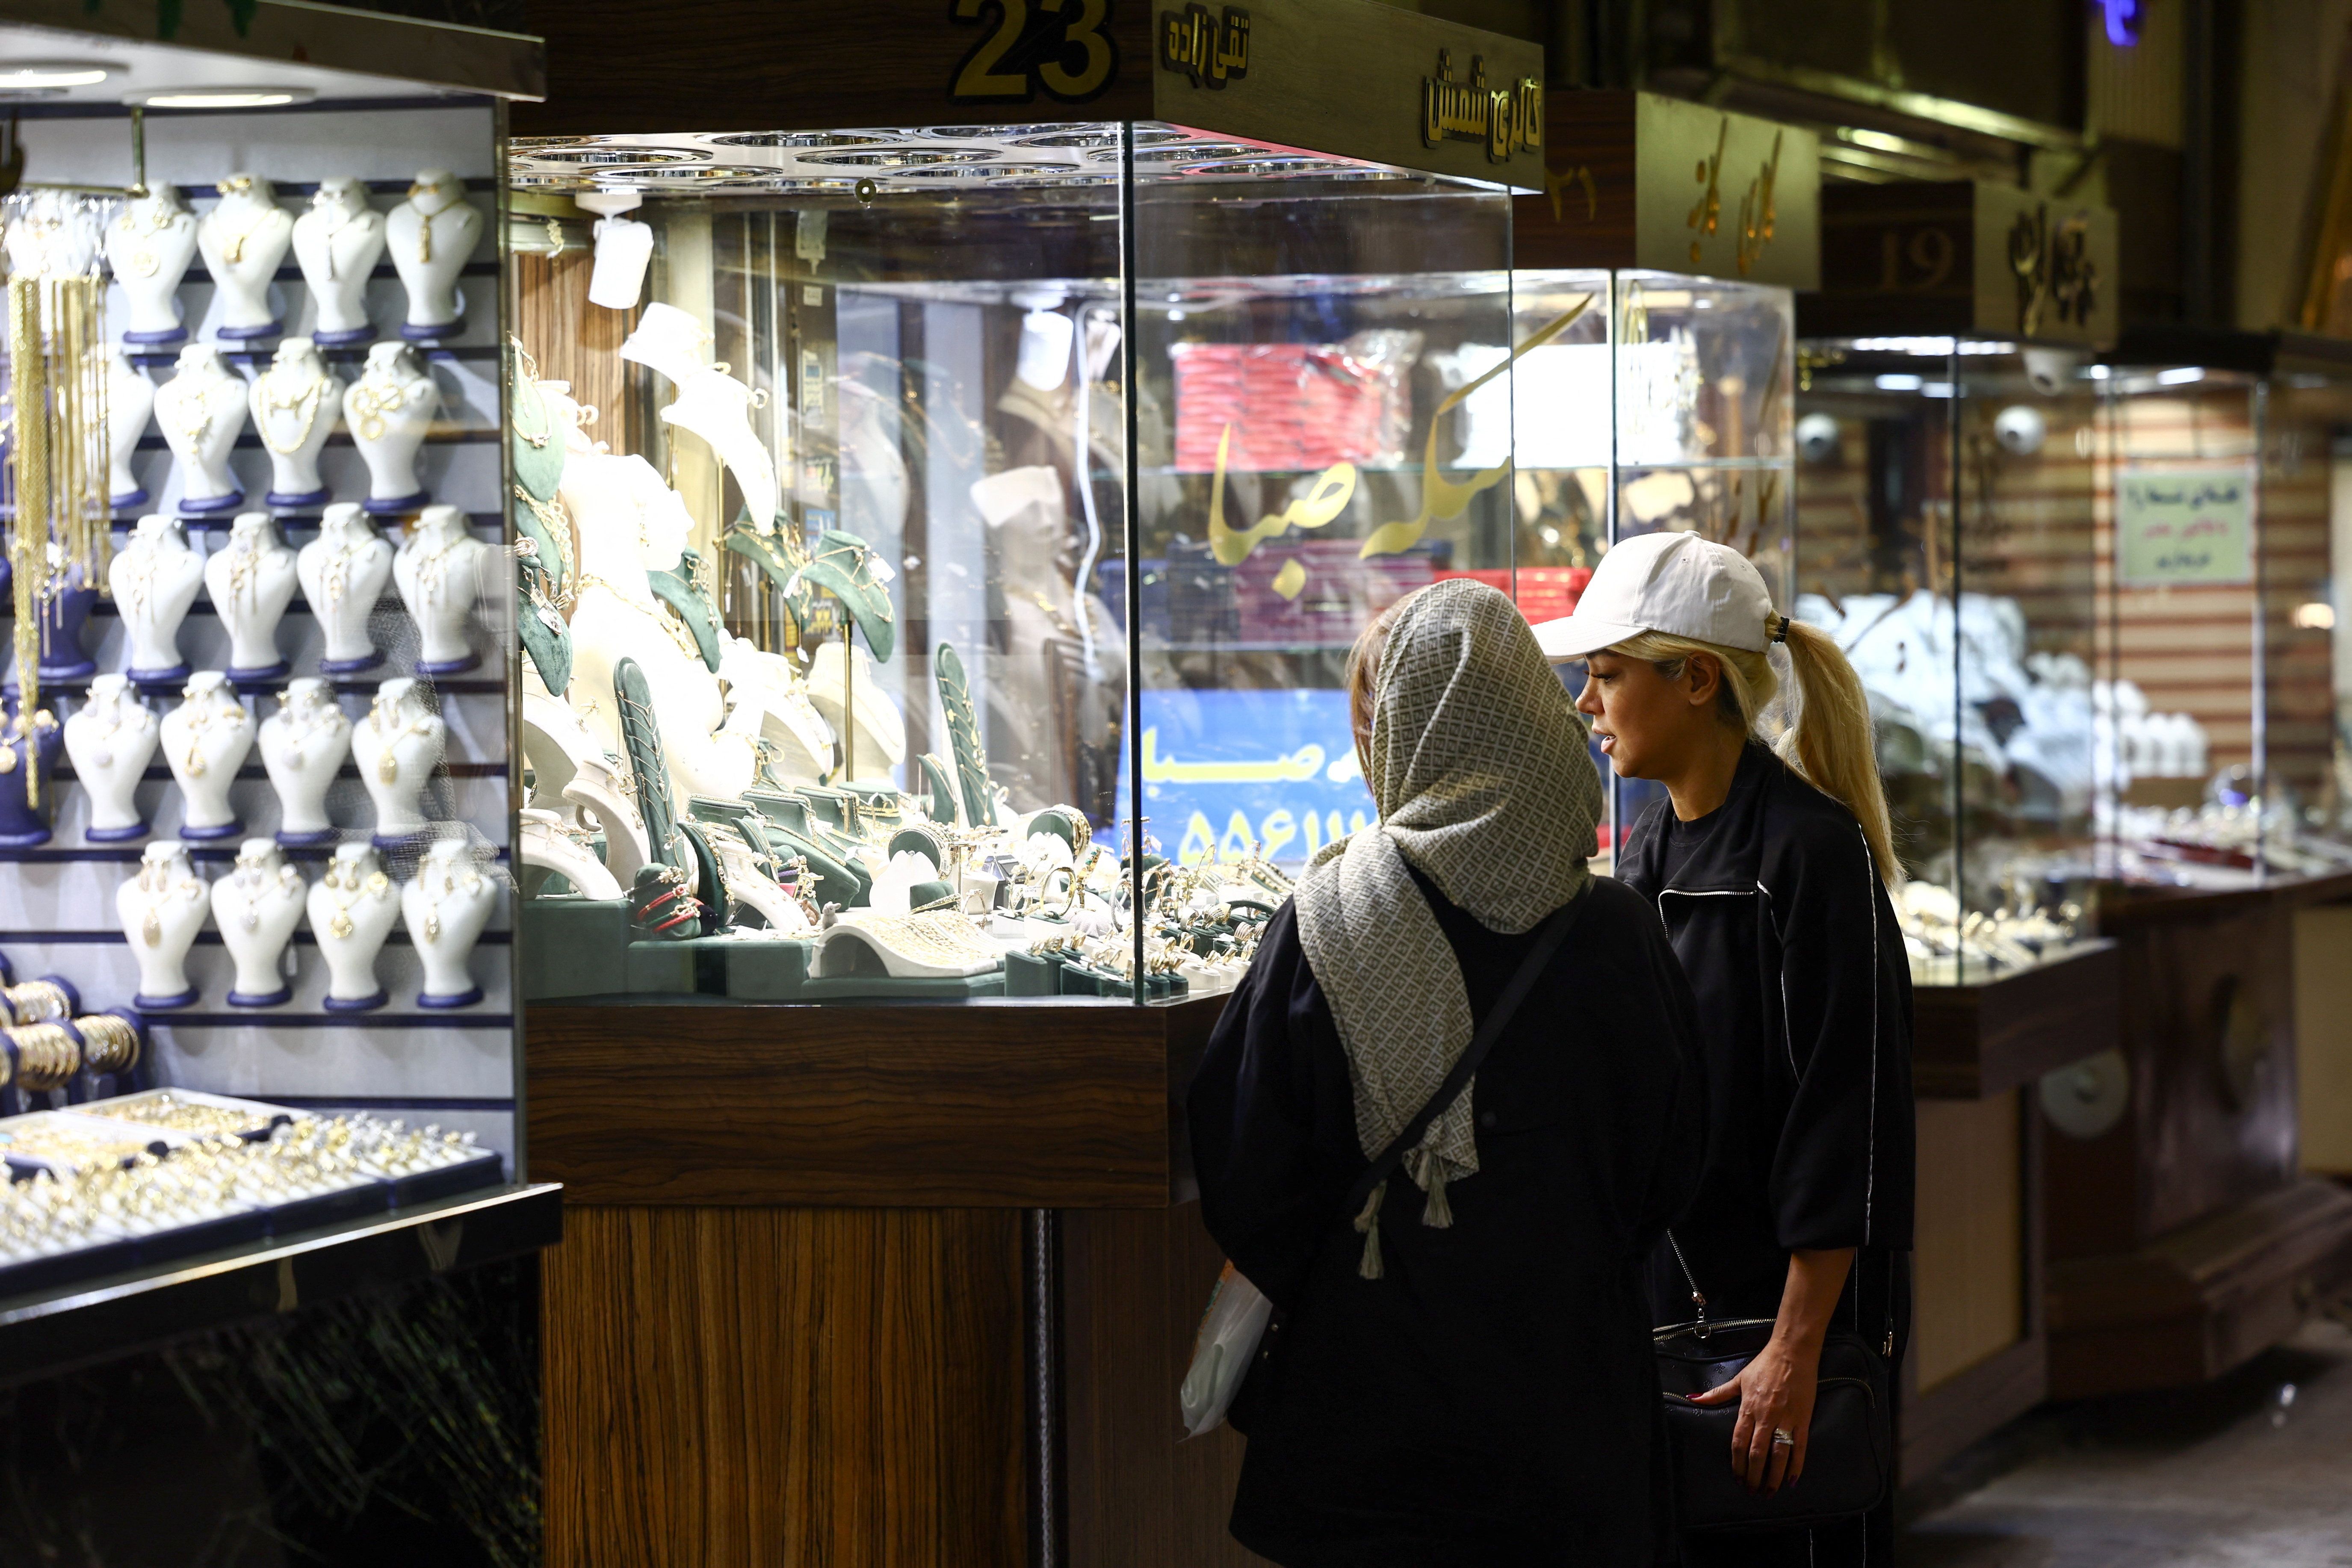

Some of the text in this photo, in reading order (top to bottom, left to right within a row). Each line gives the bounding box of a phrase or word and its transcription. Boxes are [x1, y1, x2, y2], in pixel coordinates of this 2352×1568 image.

[950, 0, 1114, 99] 23
[1166, 10, 1249, 80] تقی زاده
[1426, 53, 1542, 157] گالری شمش
[1880, 227, 1956, 292] 19
[1209, 423, 1356, 600] صبا
[1141, 726, 1325, 800] صبا
